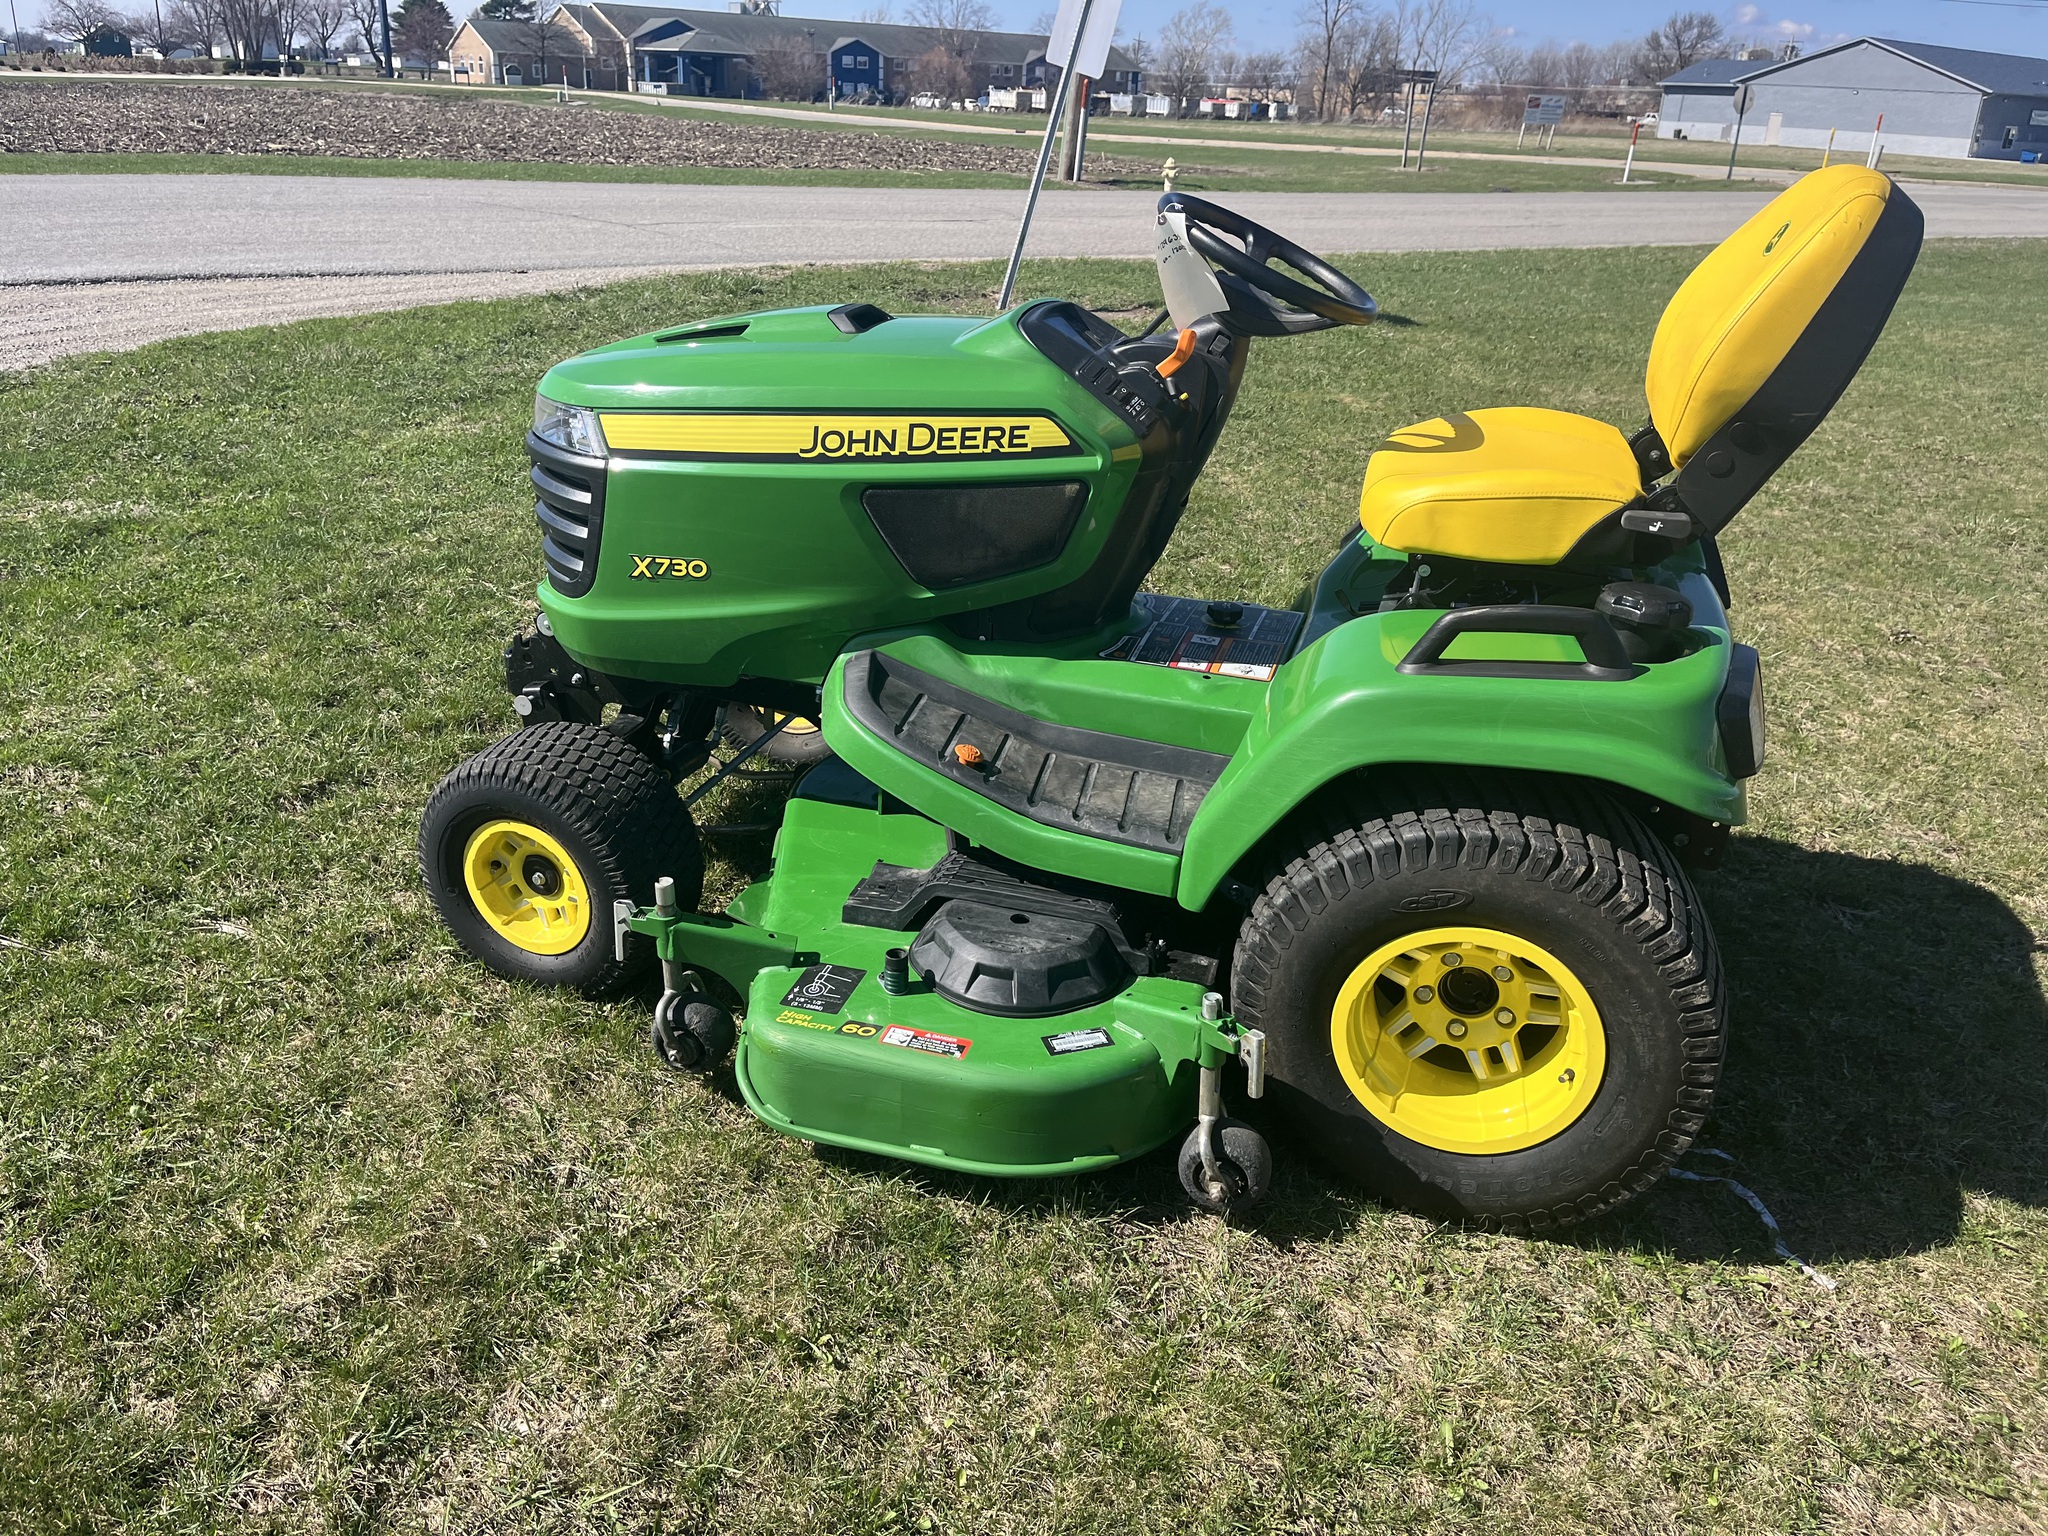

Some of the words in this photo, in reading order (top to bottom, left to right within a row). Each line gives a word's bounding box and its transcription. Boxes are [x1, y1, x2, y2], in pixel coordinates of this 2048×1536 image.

[799, 425, 898, 454] JOHN
[907, 423, 1031, 452] DEERE
[629, 554, 709, 579] X730
[1400, 892, 1455, 909] CST
[1578, 937, 1607, 962] NYLON
[780, 1009, 813, 1021] HIGH
[775, 1016, 836, 1032] CAPACITY
[841, 1023, 877, 1037] 60
[931, 1033, 958, 1043] DANGER
